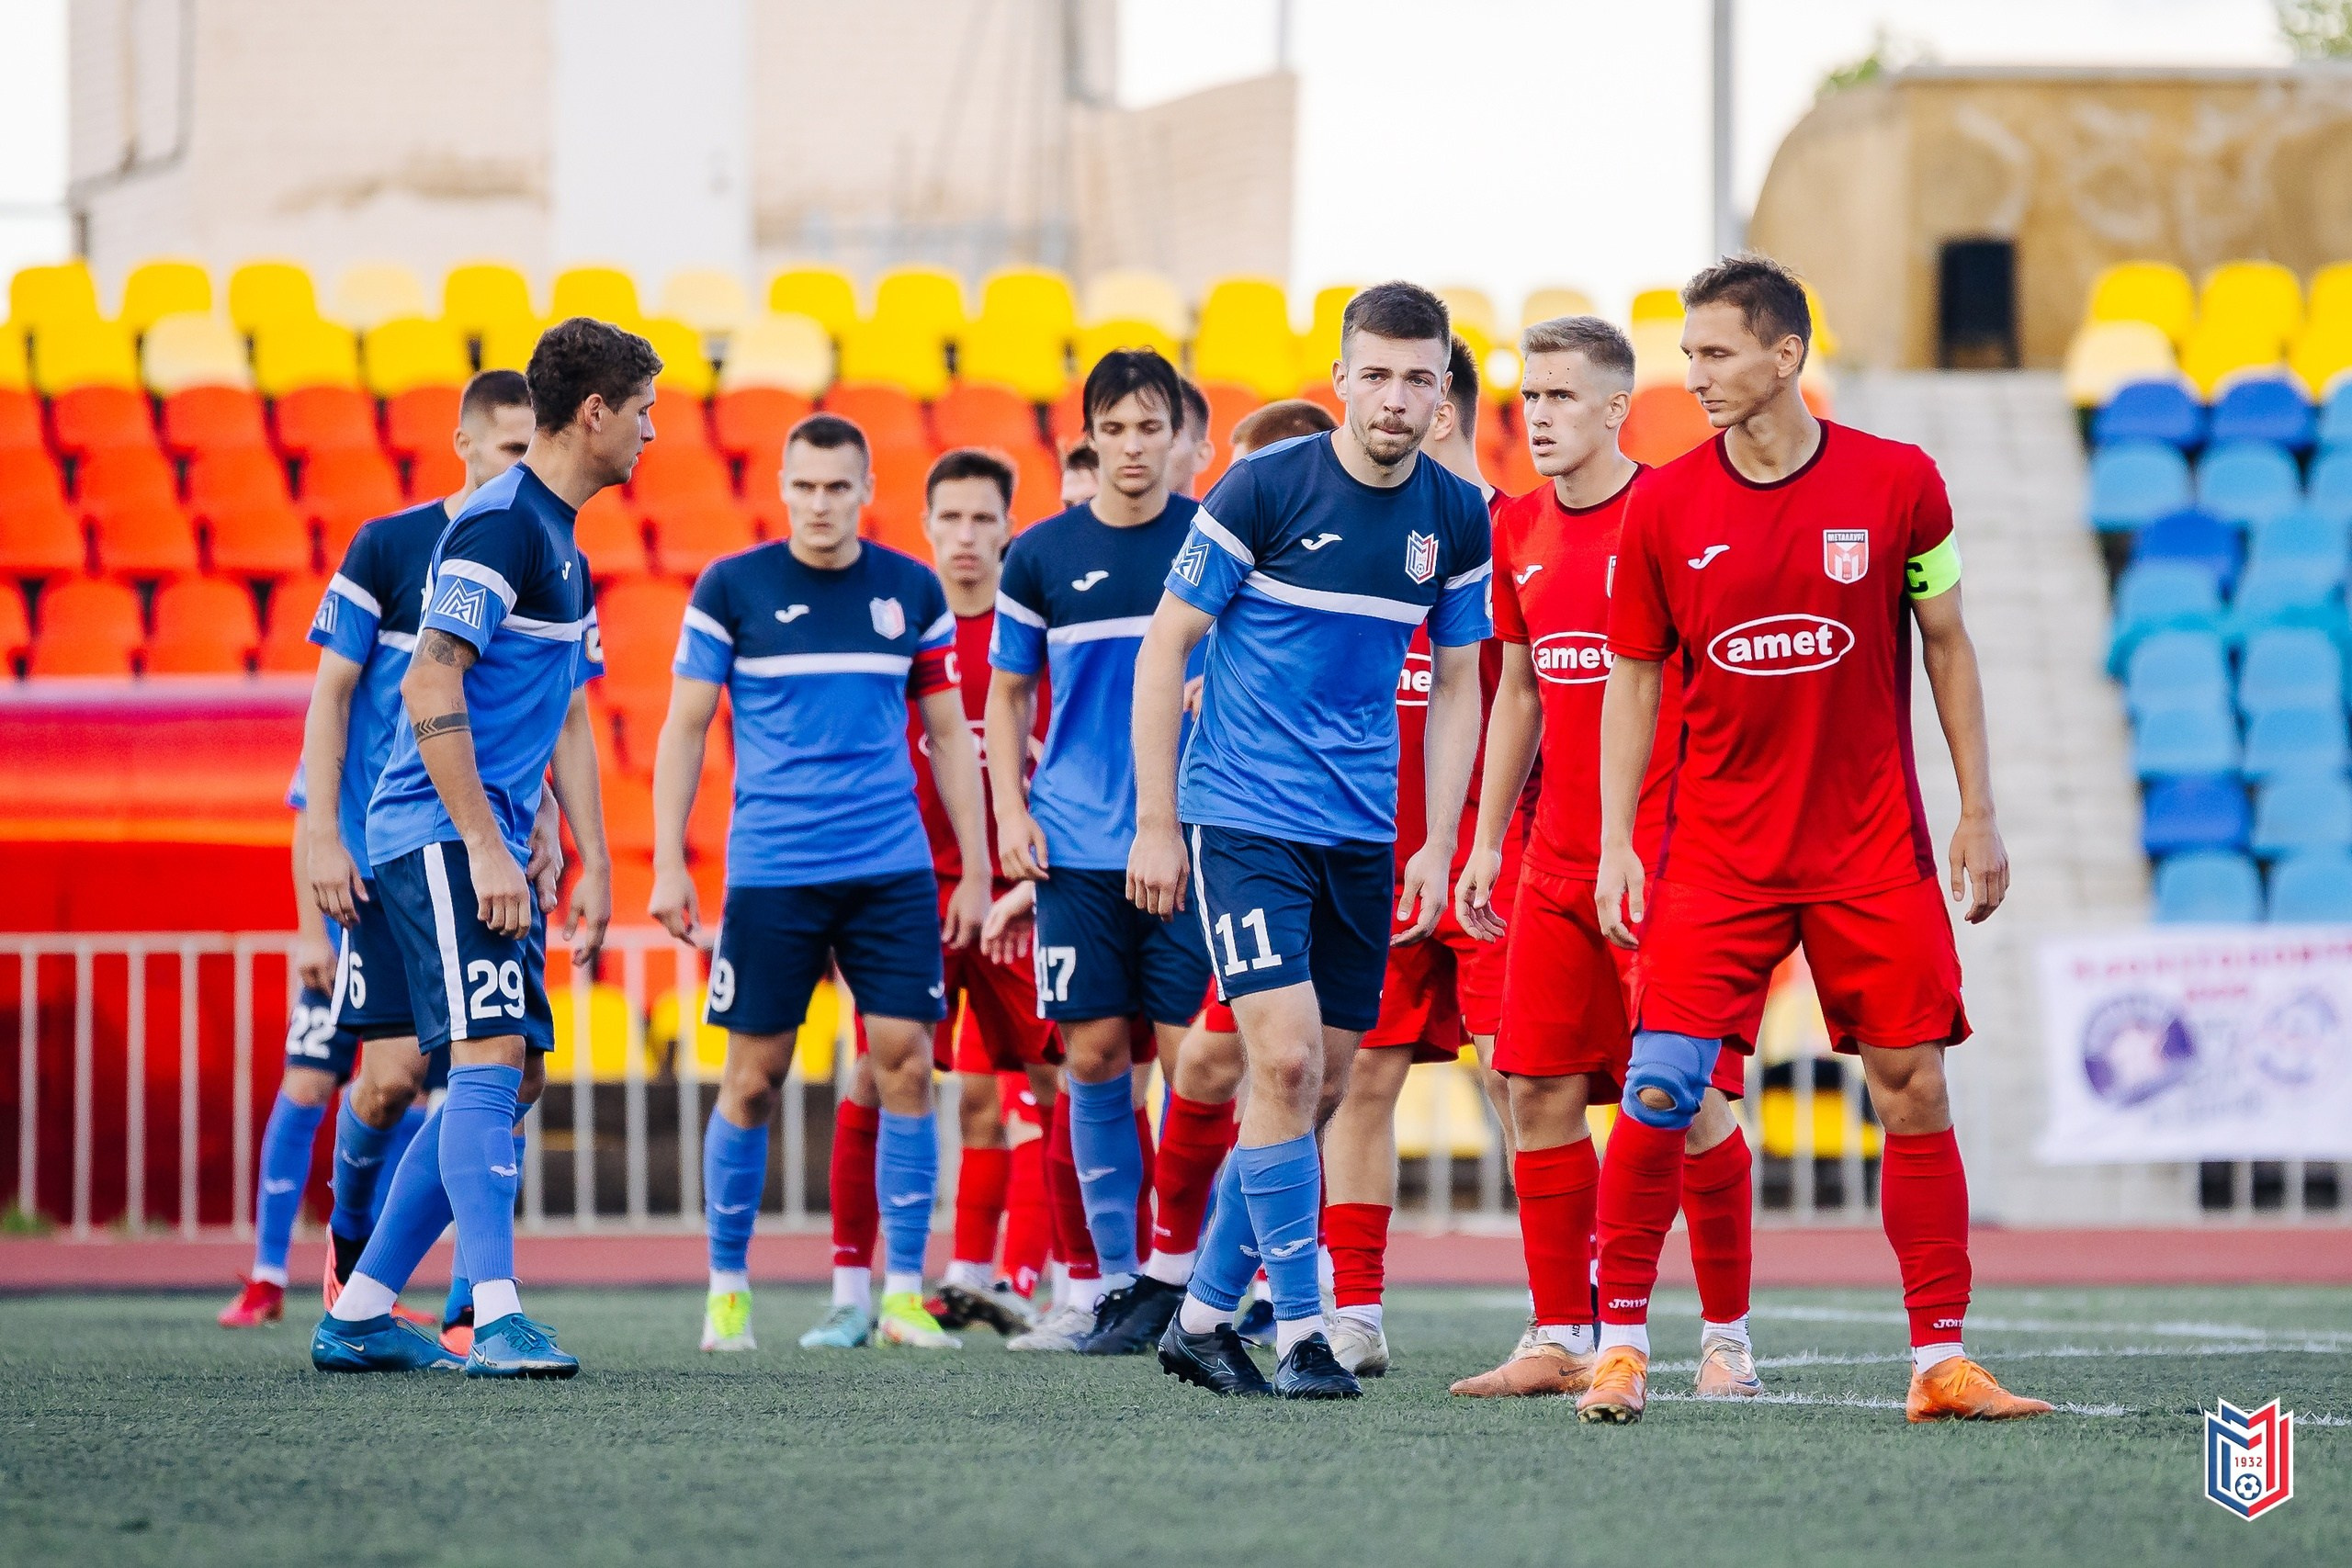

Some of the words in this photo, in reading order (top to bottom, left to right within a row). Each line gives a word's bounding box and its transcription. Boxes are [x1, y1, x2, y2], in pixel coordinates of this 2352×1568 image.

[1905, 561, 1928, 593] C
[1537, 642, 1614, 670] amet
[1726, 624, 1833, 663] amet
[1215, 908, 1283, 976] 11
[348, 952, 366, 1010] 6
[467, 959, 526, 1020] 29
[711, 957, 736, 1013] 9
[1038, 945, 1077, 1002] 17
[286, 1005, 336, 1059] 22
